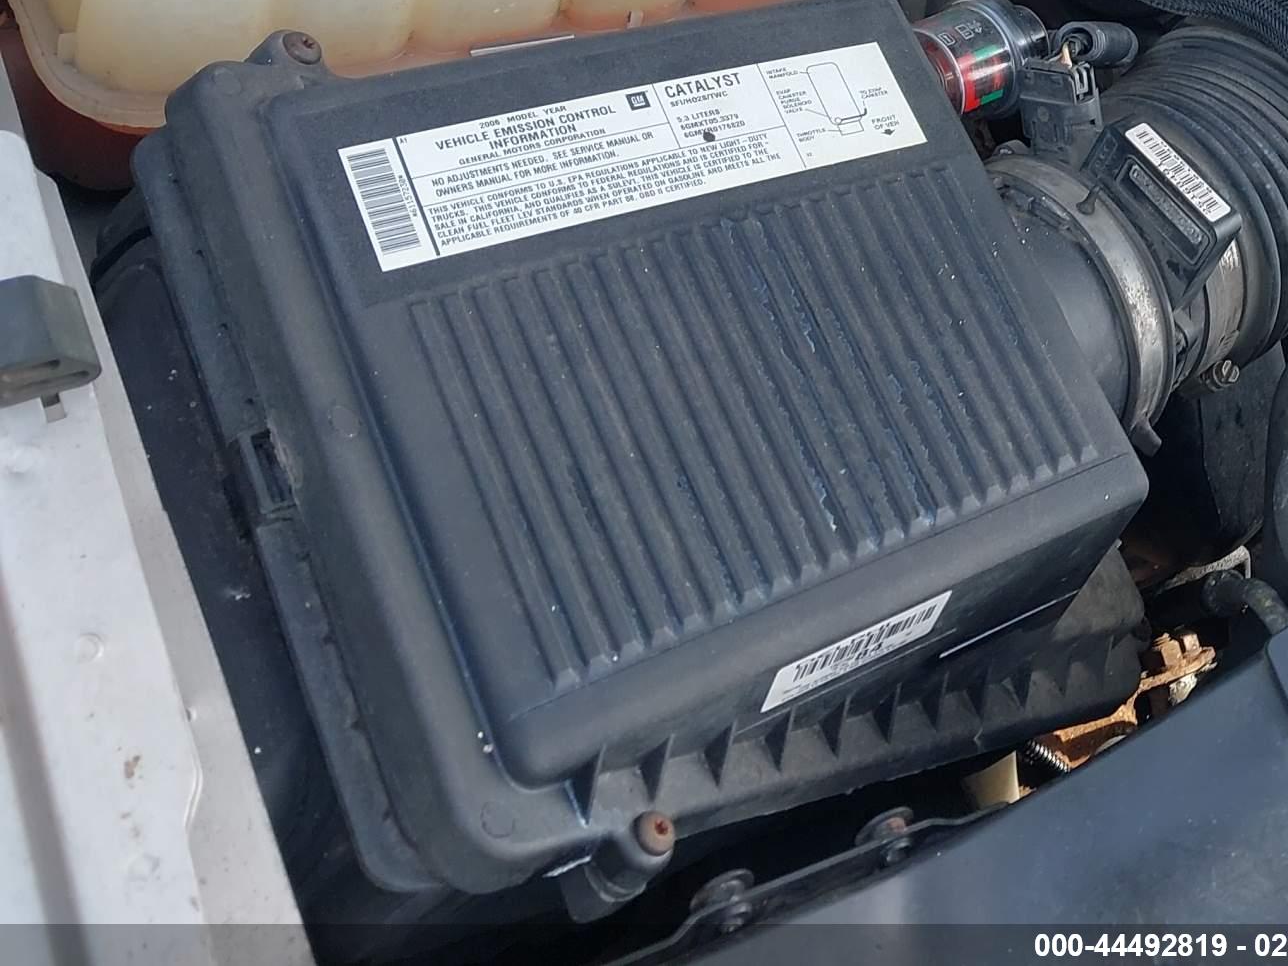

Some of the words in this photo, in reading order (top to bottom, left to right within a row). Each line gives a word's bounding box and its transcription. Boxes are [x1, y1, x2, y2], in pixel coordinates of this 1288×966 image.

[663, 72, 743, 99] CATALYST
[435, 131, 490, 150] VEHICLE
[493, 118, 555, 138] EMISSION
[559, 105, 616, 124] CONTROL
[489, 124, 577, 149] INFORMATION
[507, 112, 536, 123] MODEL
[544, 106, 567, 116] YEAR
[691, 109, 720, 120] LITERS
[871, 115, 896, 124] FRONT
[885, 120, 900, 128] VEH
[431, 177, 445, 187] NO
[446, 163, 509, 183] ADJUSTMENTS
[511, 155, 548, 169] NEEDED.
[553, 151, 568, 160] SEE
[570, 143, 604, 156] SERVICE
[606, 135, 640, 148] MANUAL
[641, 132, 654, 141] OR
[458, 151, 501, 165] GENERAL
[503, 142, 541, 155] MOTORS
[543, 128, 606, 147] CORPORATION
[428, 204, 448, 215] THIS
[450, 196, 484, 210] VEHICLE
[486, 185, 534, 202] CONFORMS
[536, 183, 546, 191] TO
[567, 174, 583, 184] EPA
[585, 162, 639, 180] REGULATIONS
[640, 151, 686, 167] APPLICABLE
[700, 144, 718, 154] NEW
[719, 139, 742, 149] LIGHT
[748, 133, 768, 143] DUTY
[434, 220, 455, 230] SALE
[458, 217, 467, 225] IN
[523, 200, 542, 210] AND
[543, 190, 585, 205] QUALIFIES
[587, 187, 598, 195] AS
[641, 173, 659, 183] THIS
[661, 166, 692, 178] VEHICLE
[703, 155, 741, 169] CERTIFIED
[754, 148, 768, 157] THE
[435, 182, 474, 197] OWNERS
[476, 173, 512, 188] MANUAL
[514, 169, 532, 179] FOR
[533, 163, 558, 175] MORE
[559, 150, 619, 169] INFORMATION.
[437, 226, 465, 239] CLEAN
[467, 221, 489, 232] FUEL
[491, 215, 515, 226] FLEET
[517, 210, 534, 220] LEV
[535, 199, 584, 216] STANDARDS
[585, 193, 610, 204] WHEN
[612, 183, 653, 198] OPERATED
[654, 180, 667, 188] ON
[668, 171, 706, 185] GASOLINE
[707, 167, 724, 176] AND
[725, 161, 750, 172] MEETS
[751, 157, 765, 166] ALL
[767, 153, 781, 162] THE
[473, 203, 493, 213] THIS
[494, 195, 528, 208] VEHICLE
[531, 184, 576, 200] CONFORMS
[578, 181, 589, 189] TO
[591, 173, 626, 186] FEDERAL
[627, 160, 681, 178] REGULATIONS
[682, 157, 698, 165] AND
[709, 146, 747, 159] CERTIFIED
[748, 142, 764, 150] FOR
[440, 228, 492, 247] APPLICABLE
[494, 213, 558, 234] REQUIREMENTS
[560, 210, 571, 219] OF
[584, 203, 601, 213] CFR
[602, 198, 624, 209] PART
